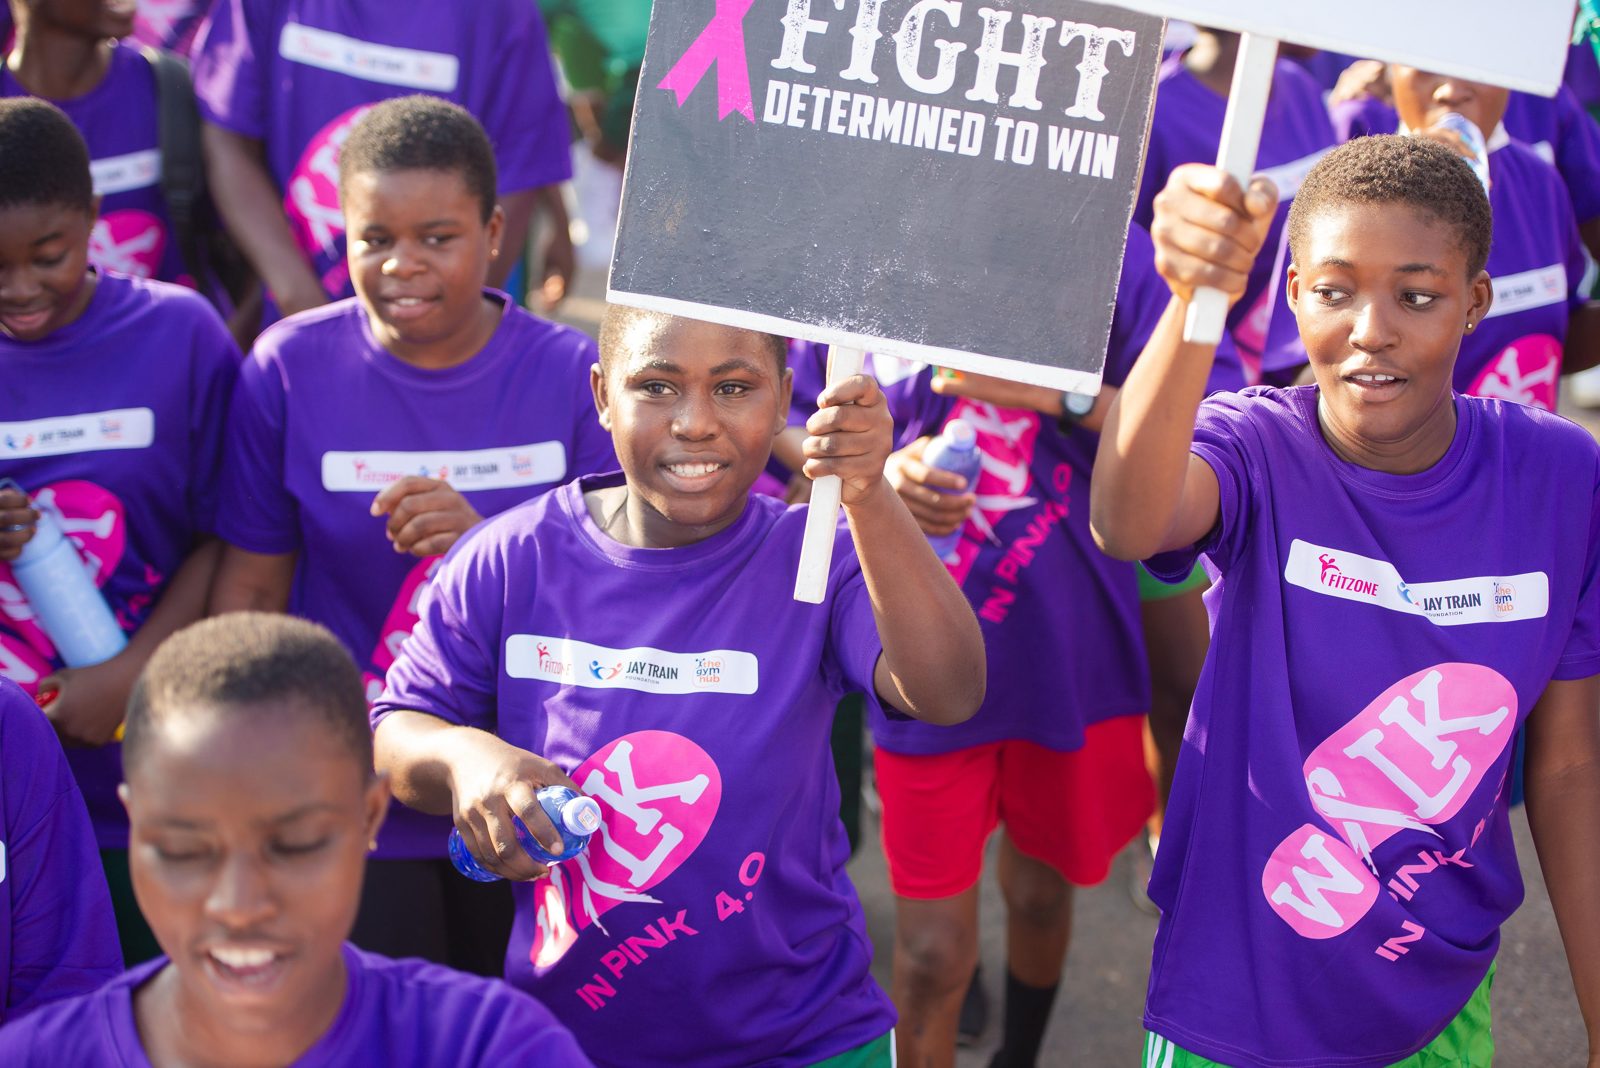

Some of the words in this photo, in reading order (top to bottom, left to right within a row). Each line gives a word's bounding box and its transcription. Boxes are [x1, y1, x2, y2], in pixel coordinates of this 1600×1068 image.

[770, 0, 1136, 122] FIGHT
[763, 79, 986, 157] DETERMINED
[994, 116, 1039, 165] TO
[1048, 125, 1119, 180] WIN
[1423, 597, 1443, 611] JAY
[1445, 592, 1482, 609] TRAIN
[626, 661, 647, 674] JAY
[648, 663, 679, 680] TRAIN
[696, 667, 720, 677] gym
[1387, 847, 1475, 902] INK
[576, 973, 617, 1012] IN
[600, 909, 699, 980] PINK
[715, 851, 766, 922] 4.0
[1375, 919, 1426, 962] IN
